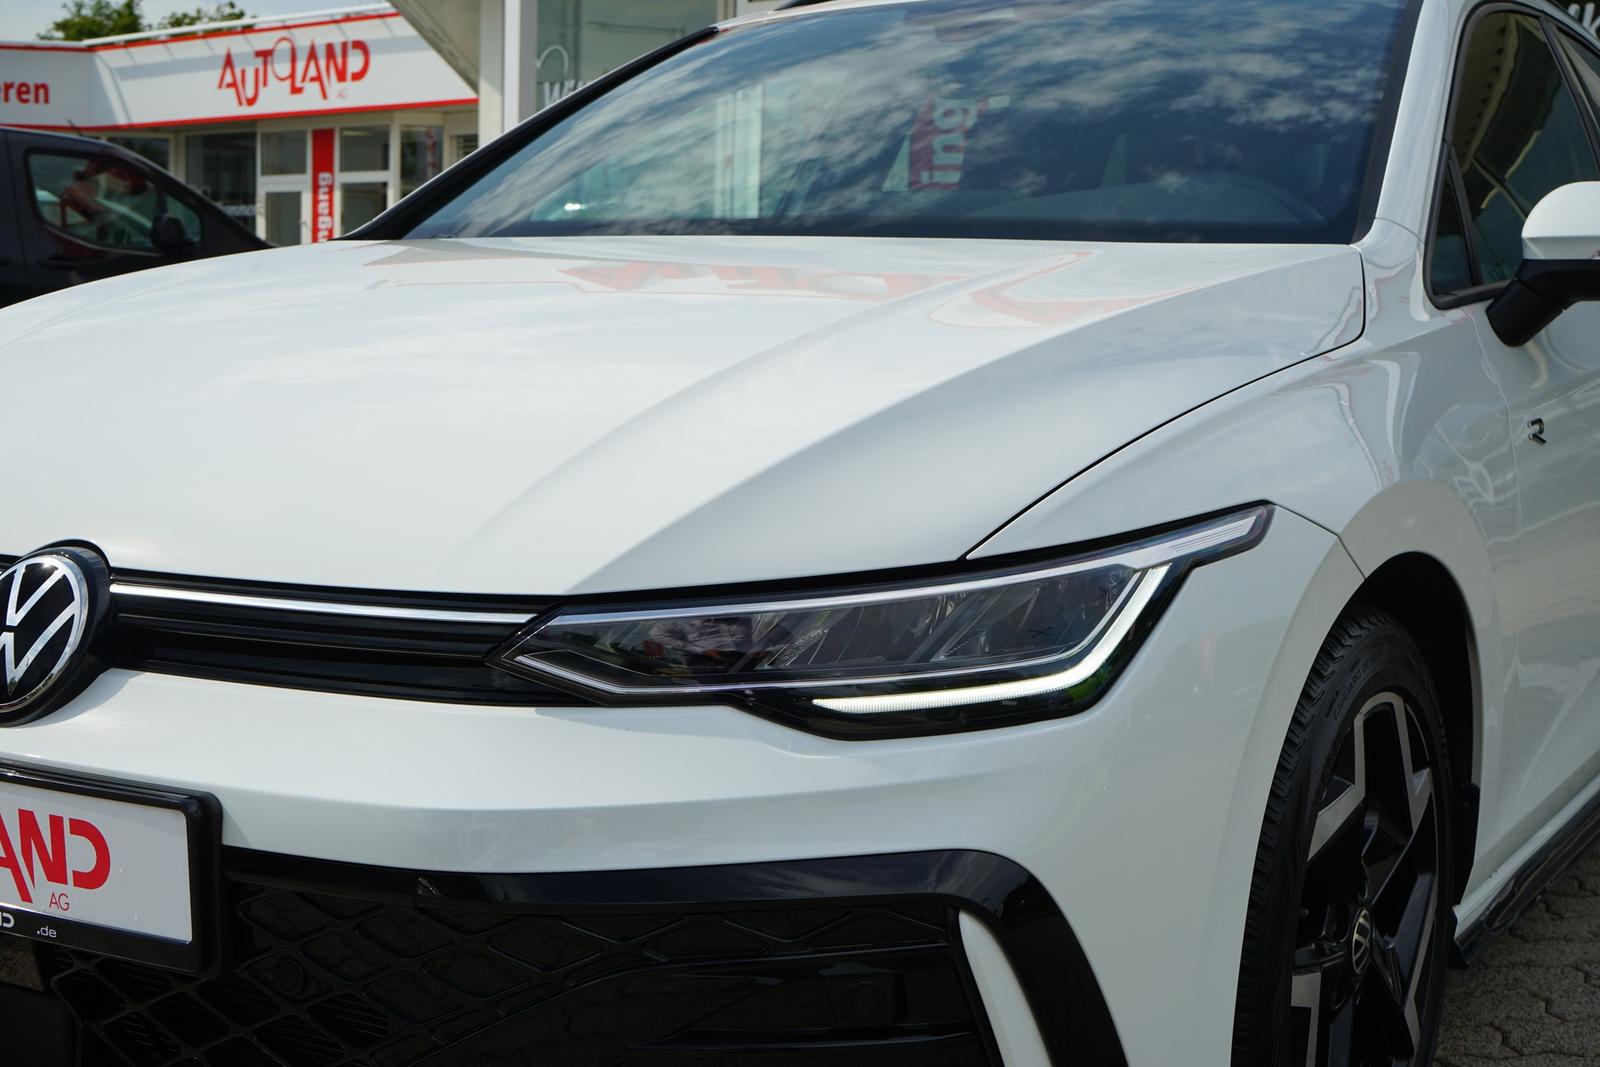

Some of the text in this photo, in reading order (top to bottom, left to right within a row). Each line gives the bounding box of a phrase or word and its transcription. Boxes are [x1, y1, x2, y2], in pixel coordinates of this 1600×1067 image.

[218, 36, 371, 107] AUTOLAND
[0, 81, 50, 105] ren
[49, 892, 70, 911] AG
[36, 925, 57, 938] .de
